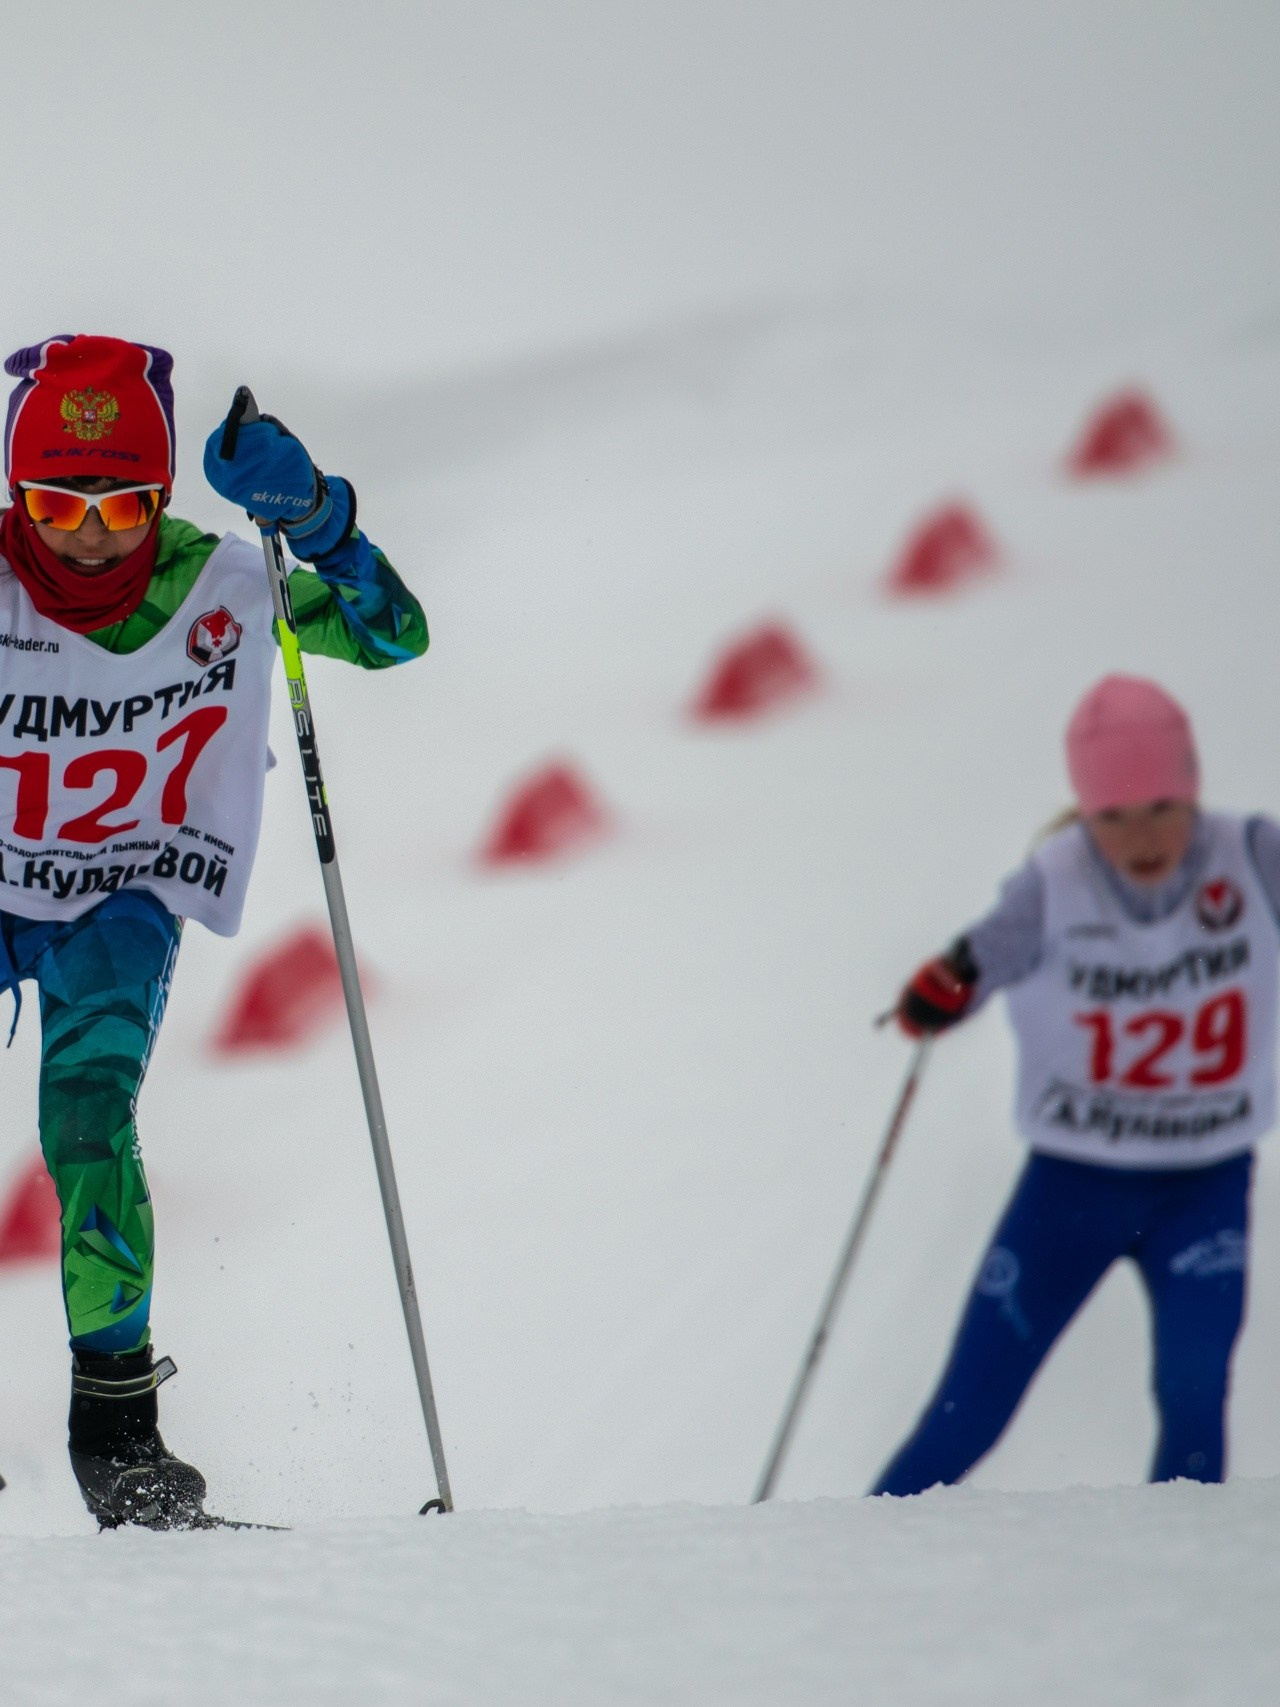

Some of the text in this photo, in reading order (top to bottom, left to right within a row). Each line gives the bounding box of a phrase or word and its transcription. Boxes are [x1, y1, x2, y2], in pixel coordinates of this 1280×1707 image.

[251, 490, 313, 508] skikros
[111, 839, 160, 853] лыжный
[203, 833, 235, 856] имени
[1075, 985, 1246, 1088] 129
